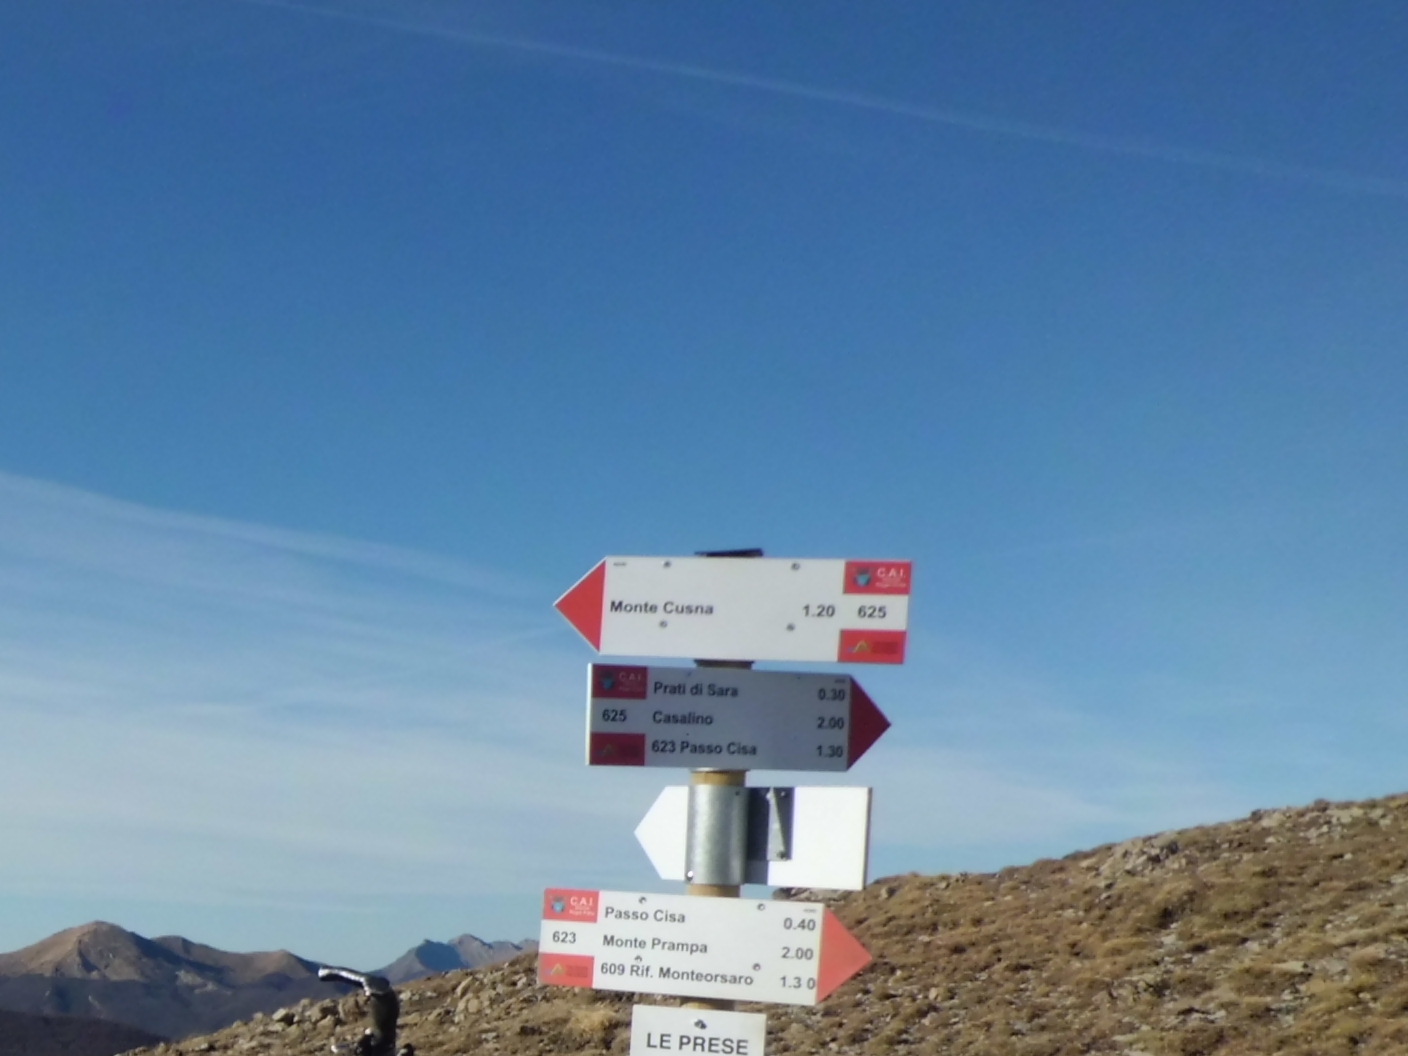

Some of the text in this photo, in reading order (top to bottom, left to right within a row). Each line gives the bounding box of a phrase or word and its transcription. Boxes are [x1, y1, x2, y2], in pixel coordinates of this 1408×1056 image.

[610, 600, 714, 615] Monte Cusna
[803, 603, 836, 618] 1.20
[857, 604, 887, 619] 625
[654, 681, 686, 695] Prati
[690, 683, 703, 696] di
[707, 683, 739, 697] Sara
[818, 688, 845, 701] 0.30
[602, 708, 627, 722] 625
[653, 710, 713, 725] Casalino
[817, 716, 844, 730] 2.00
[652, 740, 676, 753] 623
[680, 740, 723, 754] Passo
[727, 742, 757, 756] Cisa
[816, 745, 843, 758] 1.30
[604, 906, 649, 921] Passo
[653, 909, 686, 923] Cisa
[783, 917, 816, 931] 0.40
[552, 931, 577, 944] 623
[602, 934, 708, 955] Monte Prampa
[781, 946, 814, 960] 2.00
[600, 962, 625, 976] 609
[629, 964, 654, 978] Rif.
[658, 966, 754, 986] Monteorsaro
[646, 1032, 749, 1056] LE PRESE
